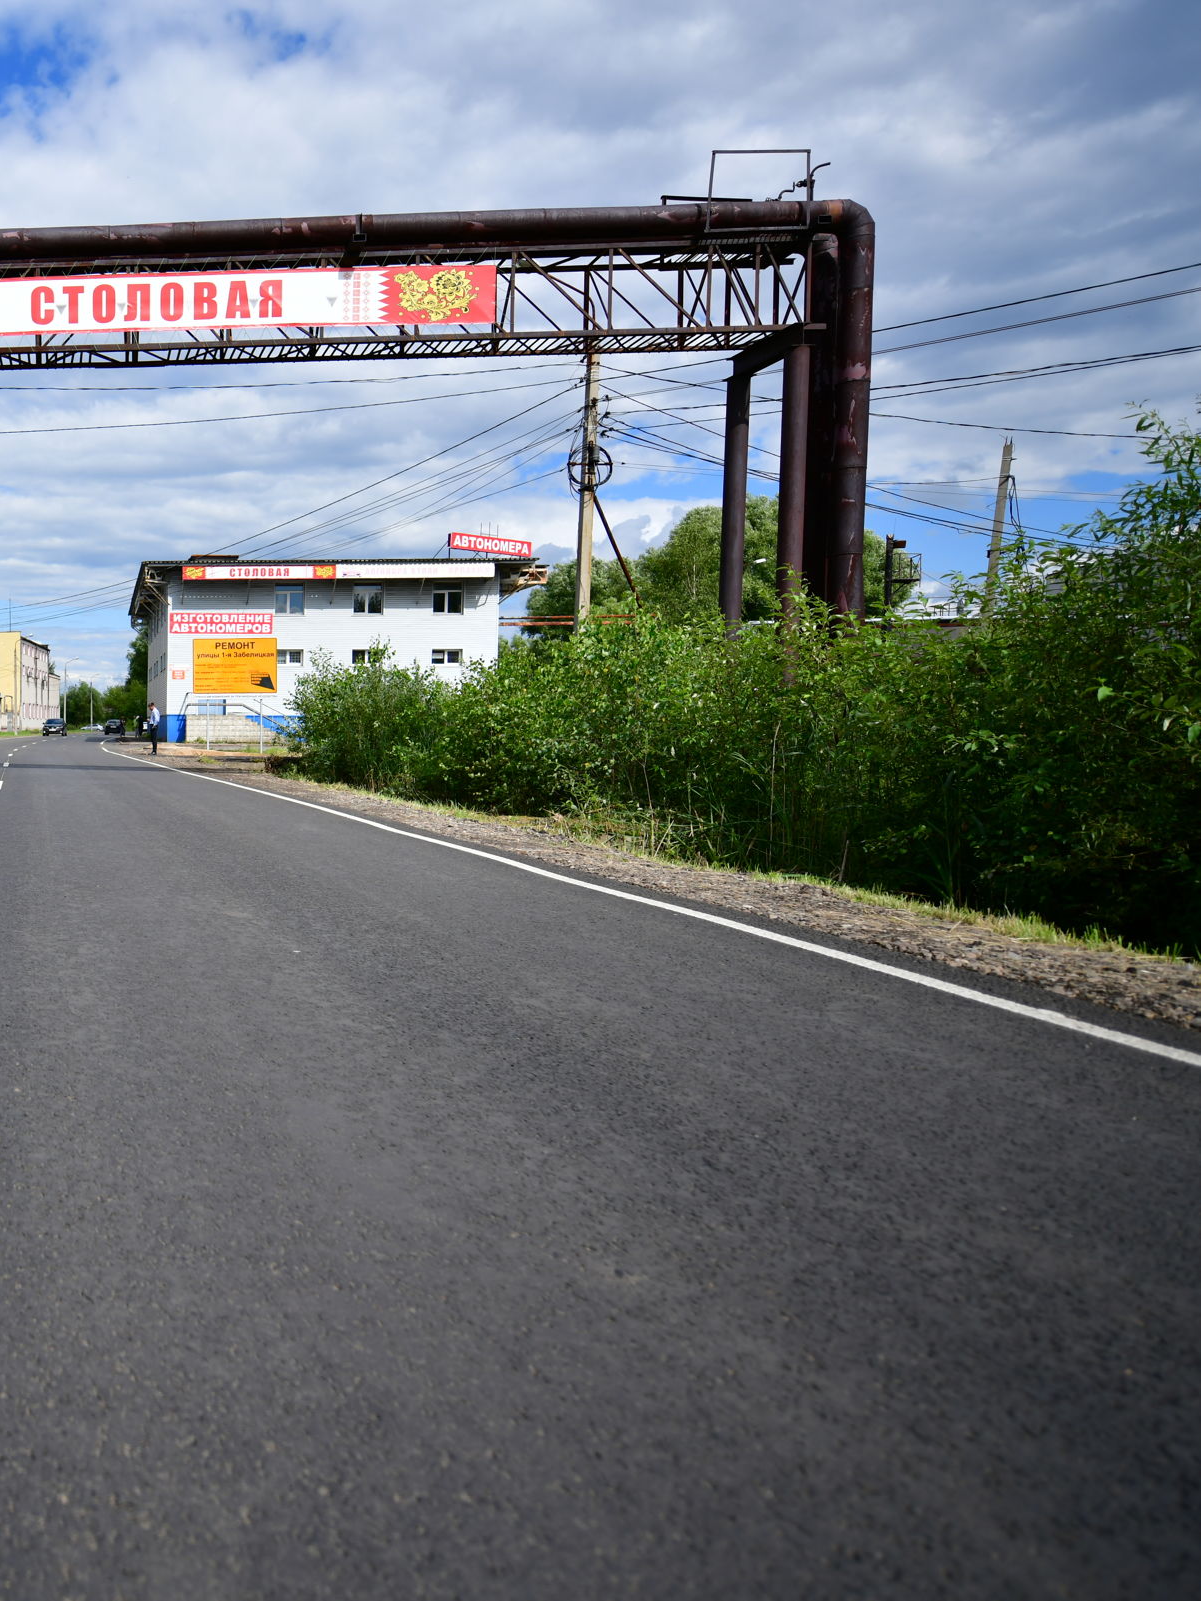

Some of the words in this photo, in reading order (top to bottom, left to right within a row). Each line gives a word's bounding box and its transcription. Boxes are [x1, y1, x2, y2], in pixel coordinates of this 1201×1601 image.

[30, 279, 283, 326] СТОЛОВАЯ
[453, 534, 529, 555] АВТОНОМЕРА
[229, 567, 290, 577] СТОЛОВАЯ
[173, 614, 272, 623] ИЗГОТОВЛЕНИЕ
[171, 623, 271, 633] АВТОНОМЕРОВ
[215, 641, 255, 650] РЕМОНТ
